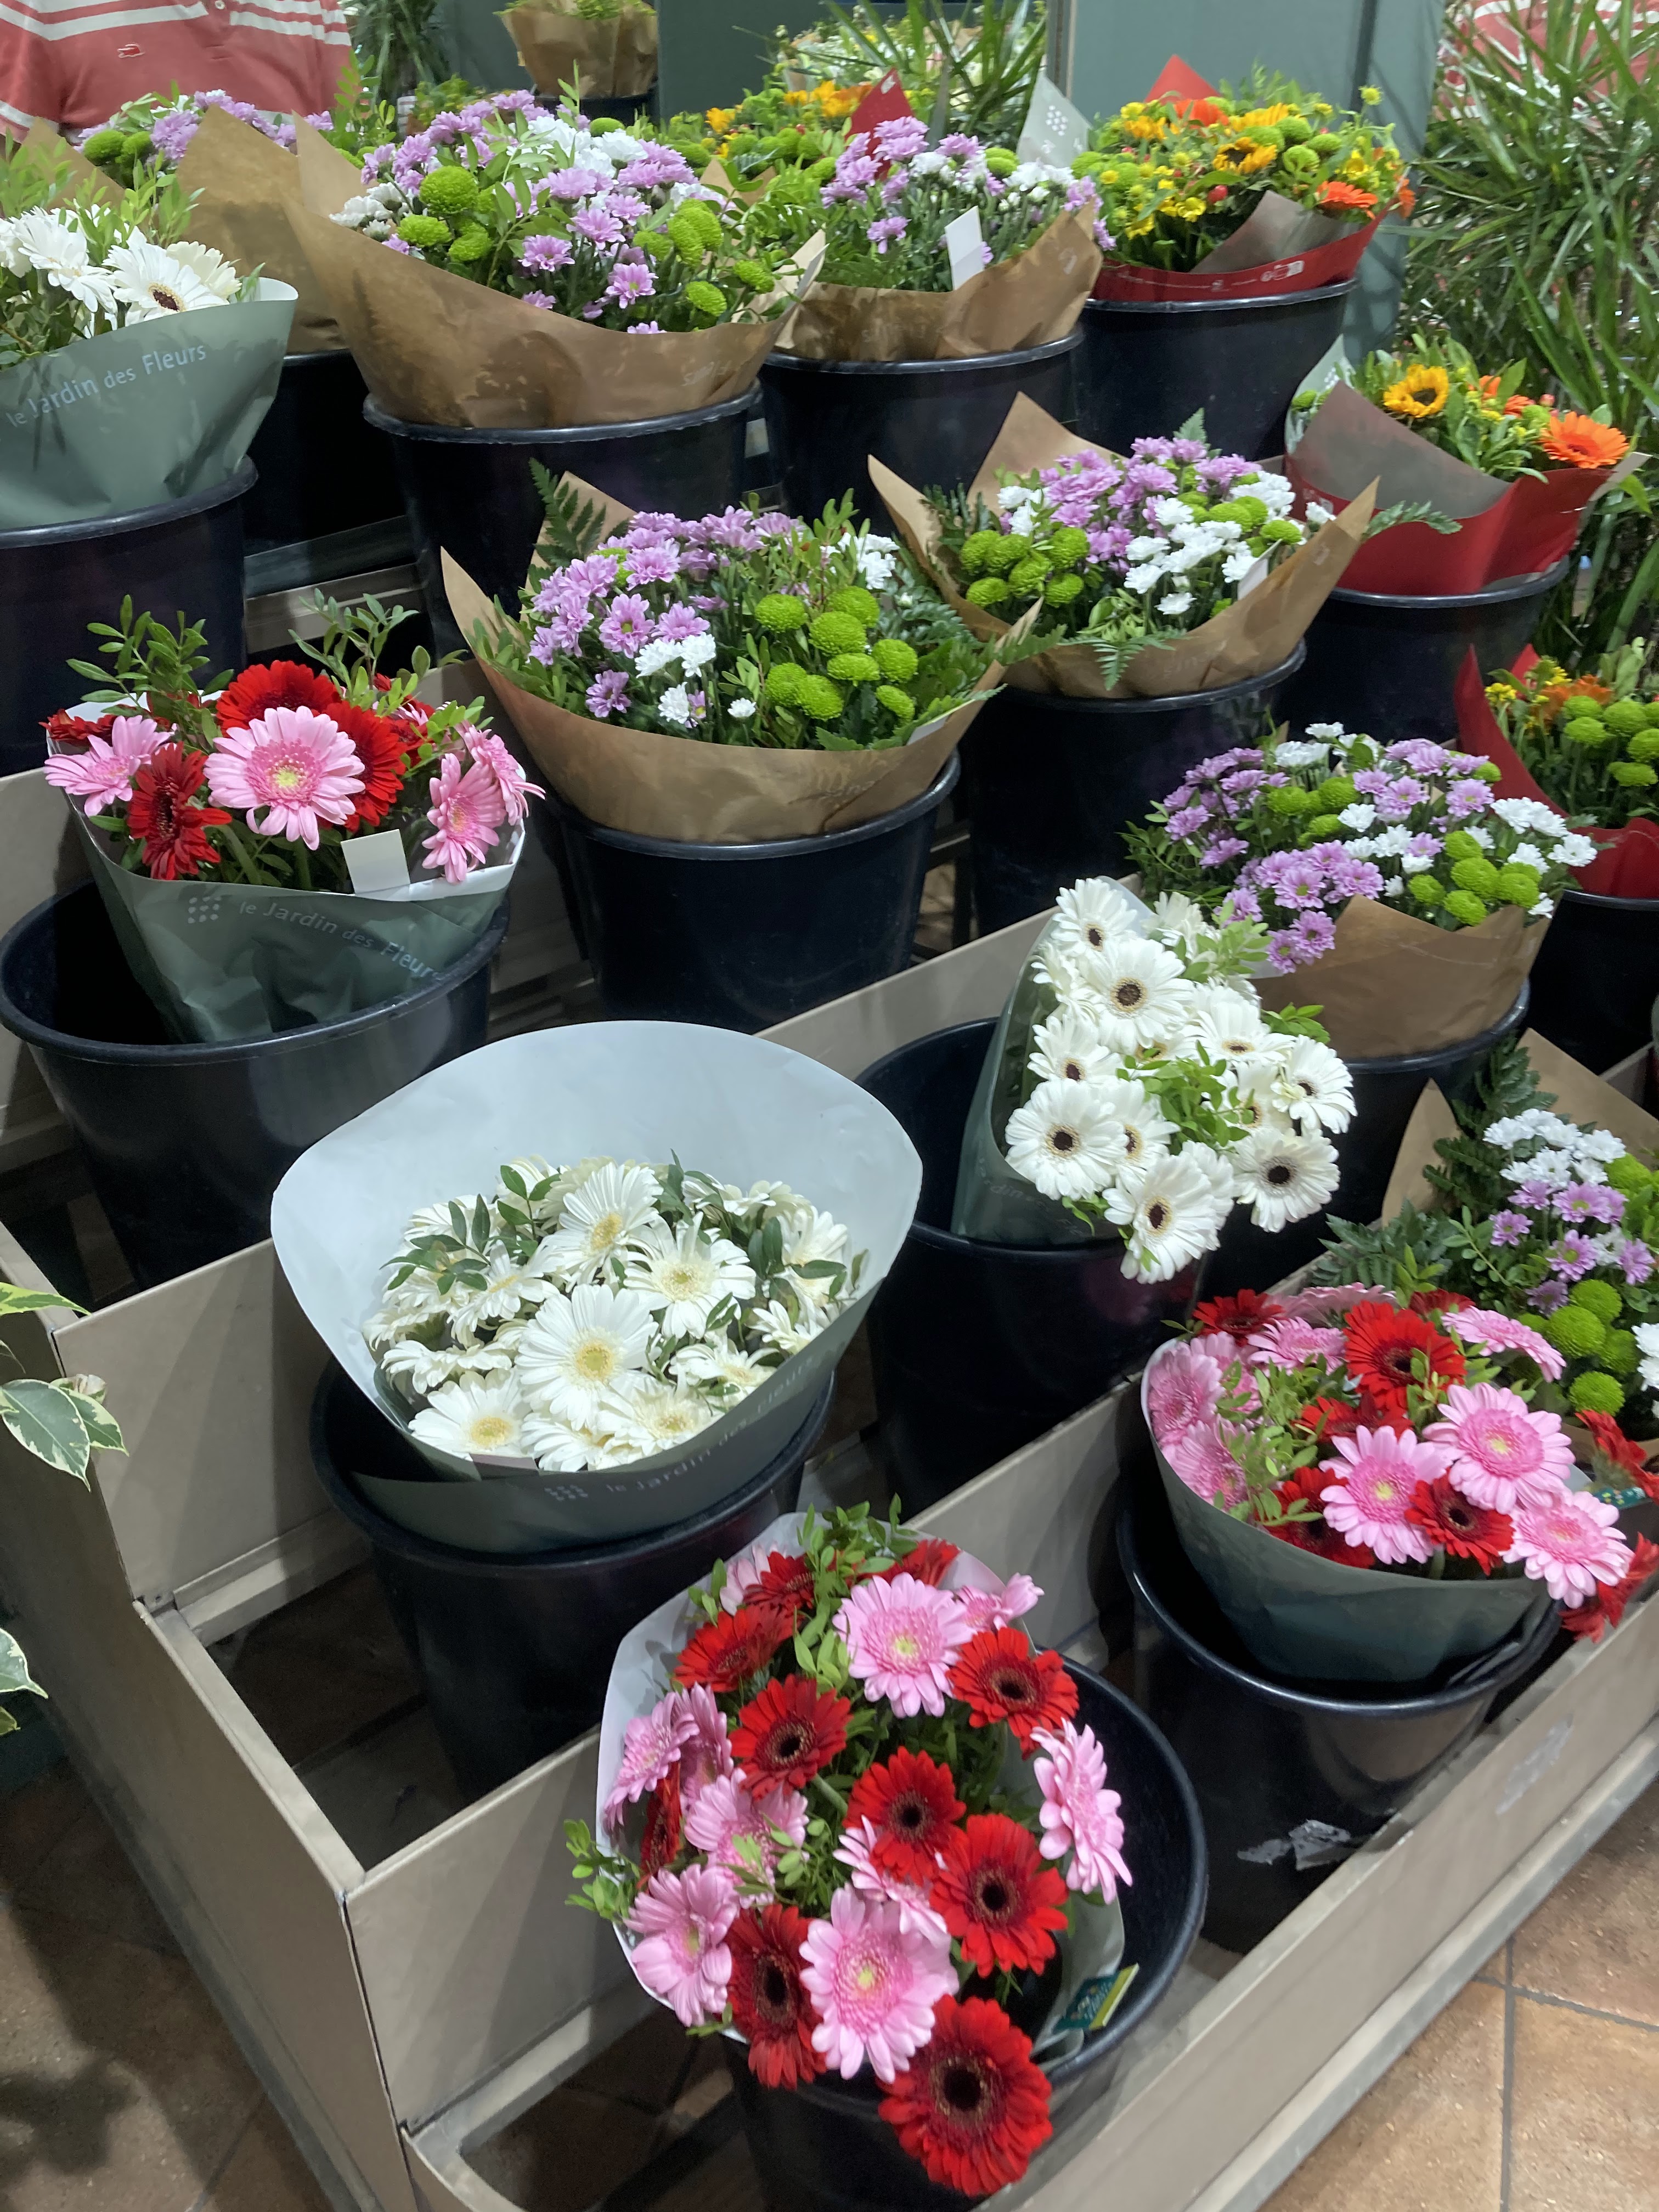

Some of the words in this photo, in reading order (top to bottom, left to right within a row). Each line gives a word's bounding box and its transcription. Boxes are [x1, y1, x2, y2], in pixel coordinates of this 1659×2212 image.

[6, 412, 27, 427] le
[27, 379, 99, 419] Jardin
[104, 368, 136, 388] des
[142, 346, 206, 375] Fleurs
[239, 901, 257, 915] le
[263, 902, 338, 934] Jardin
[341, 929, 375, 947] des
[380, 941, 446, 980] Fleurs
